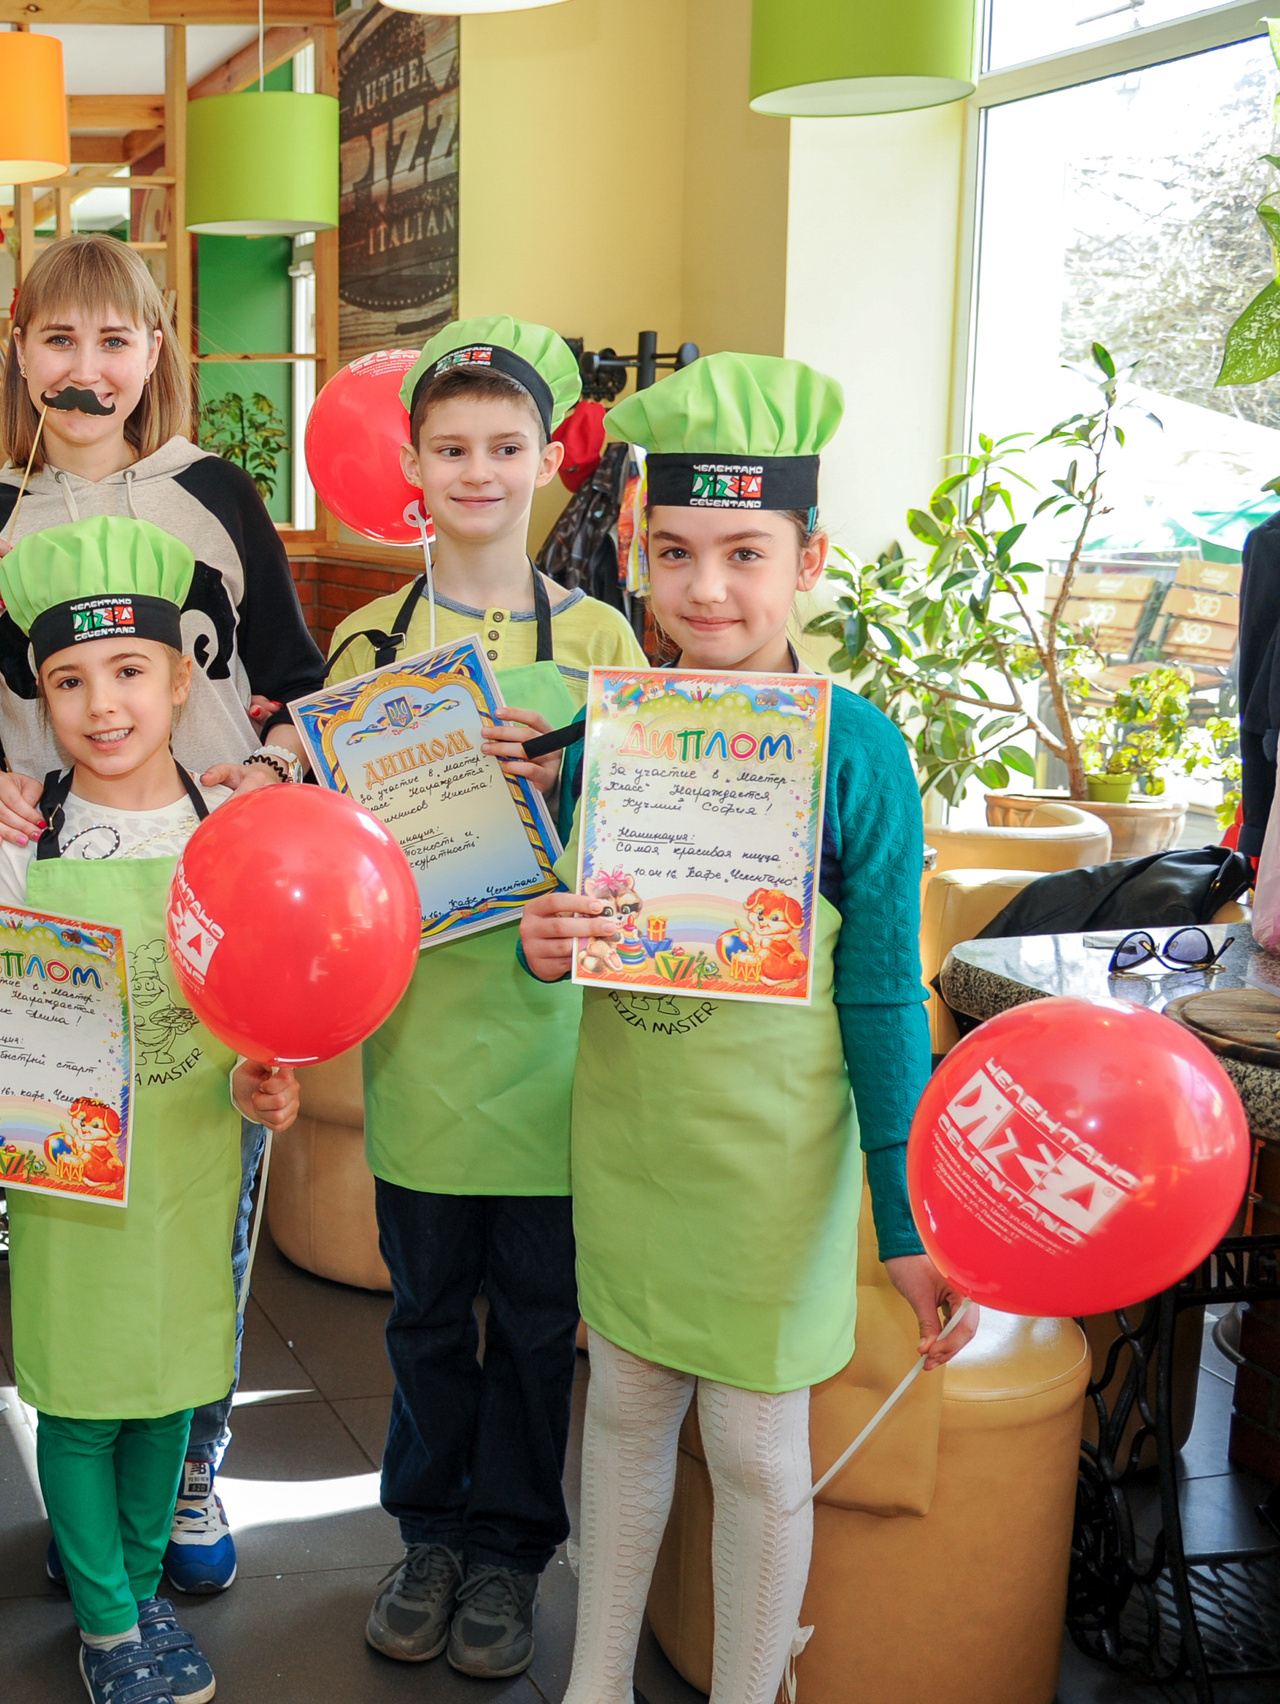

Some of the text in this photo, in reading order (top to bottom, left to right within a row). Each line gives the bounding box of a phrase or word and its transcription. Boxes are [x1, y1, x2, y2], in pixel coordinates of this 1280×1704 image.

[368, 205, 456, 254] ITALIAN
[693, 464, 763, 475] ЧЕЛЕНТАНО
[363, 728, 474, 790] ДИПЛОМ
[610, 763, 626, 776] За
[635, 767, 697, 783] участие
[608, 991, 718, 1035] PIZZA MASTER
[147, 1047, 203, 1086] MASTER
[985, 1057, 1143, 1191] ЧЕЛЕНТАНО
